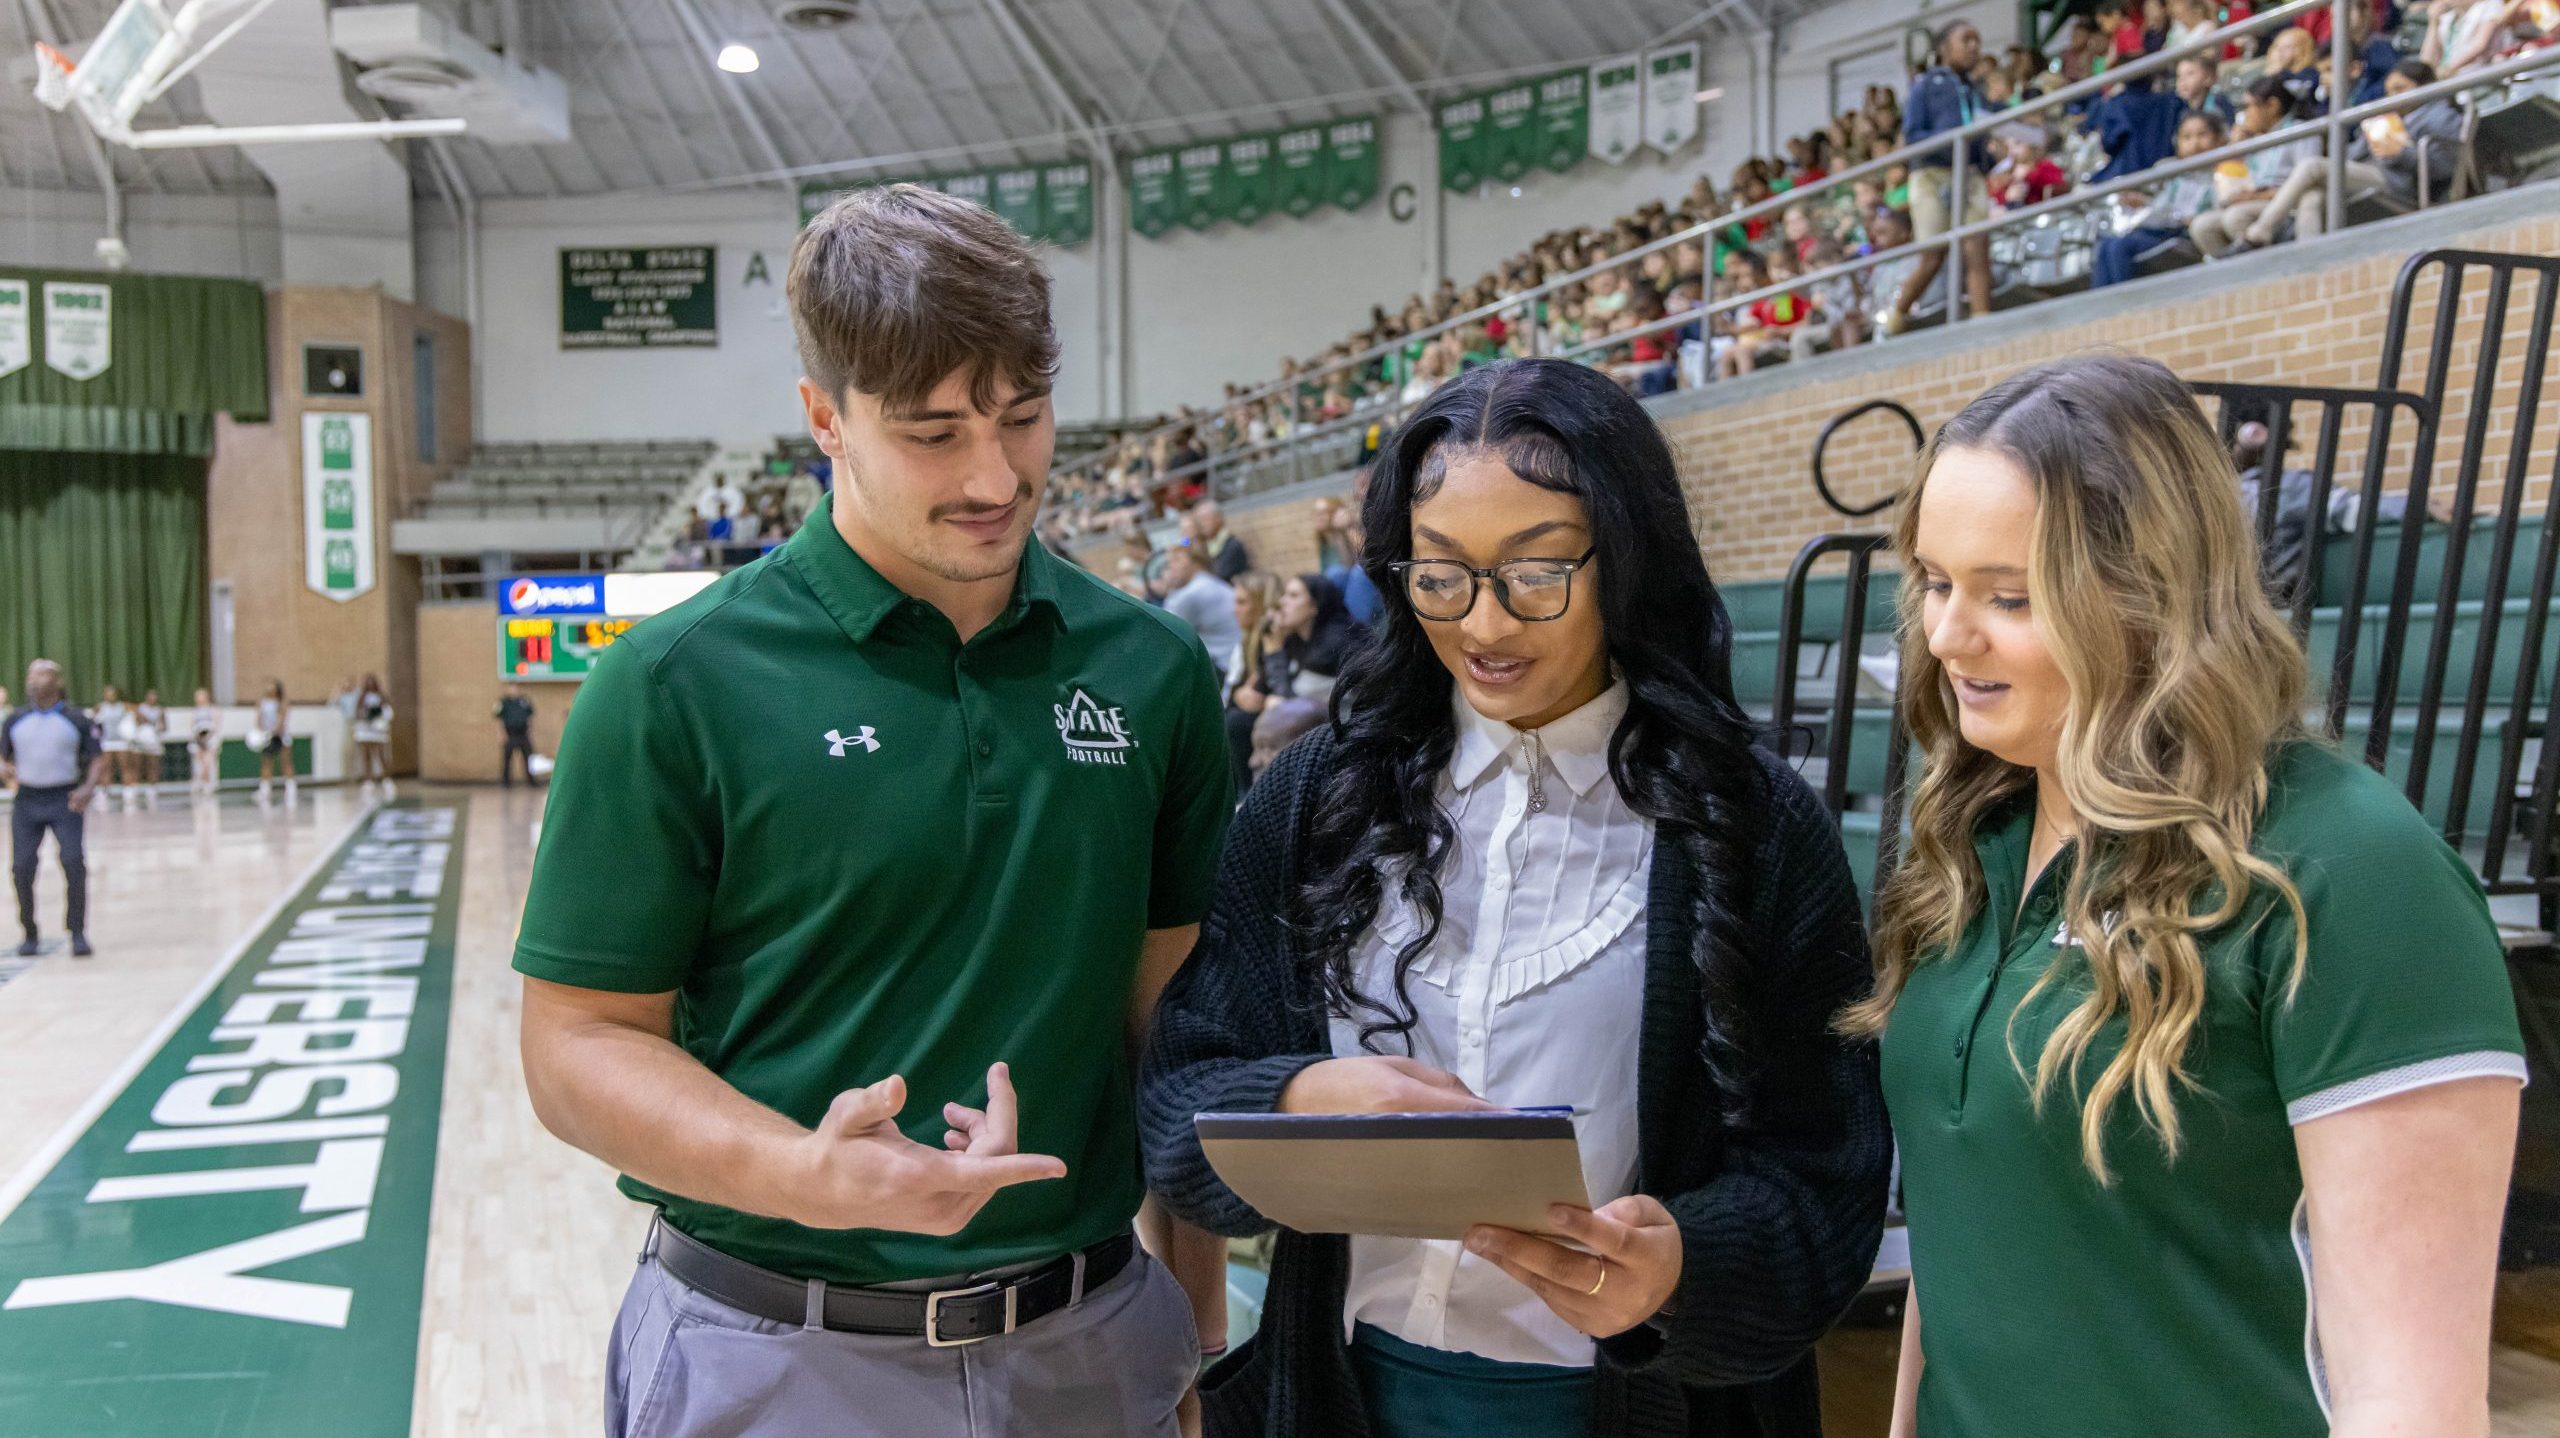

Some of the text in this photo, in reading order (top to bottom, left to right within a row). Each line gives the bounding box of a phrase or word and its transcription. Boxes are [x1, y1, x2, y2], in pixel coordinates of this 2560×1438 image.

[743, 250, 772, 287] A
[1053, 703, 1131, 735] STATE
[1066, 746, 1127, 765] FOOTBALL
[4, 902, 437, 1329] UNIVERSITY
